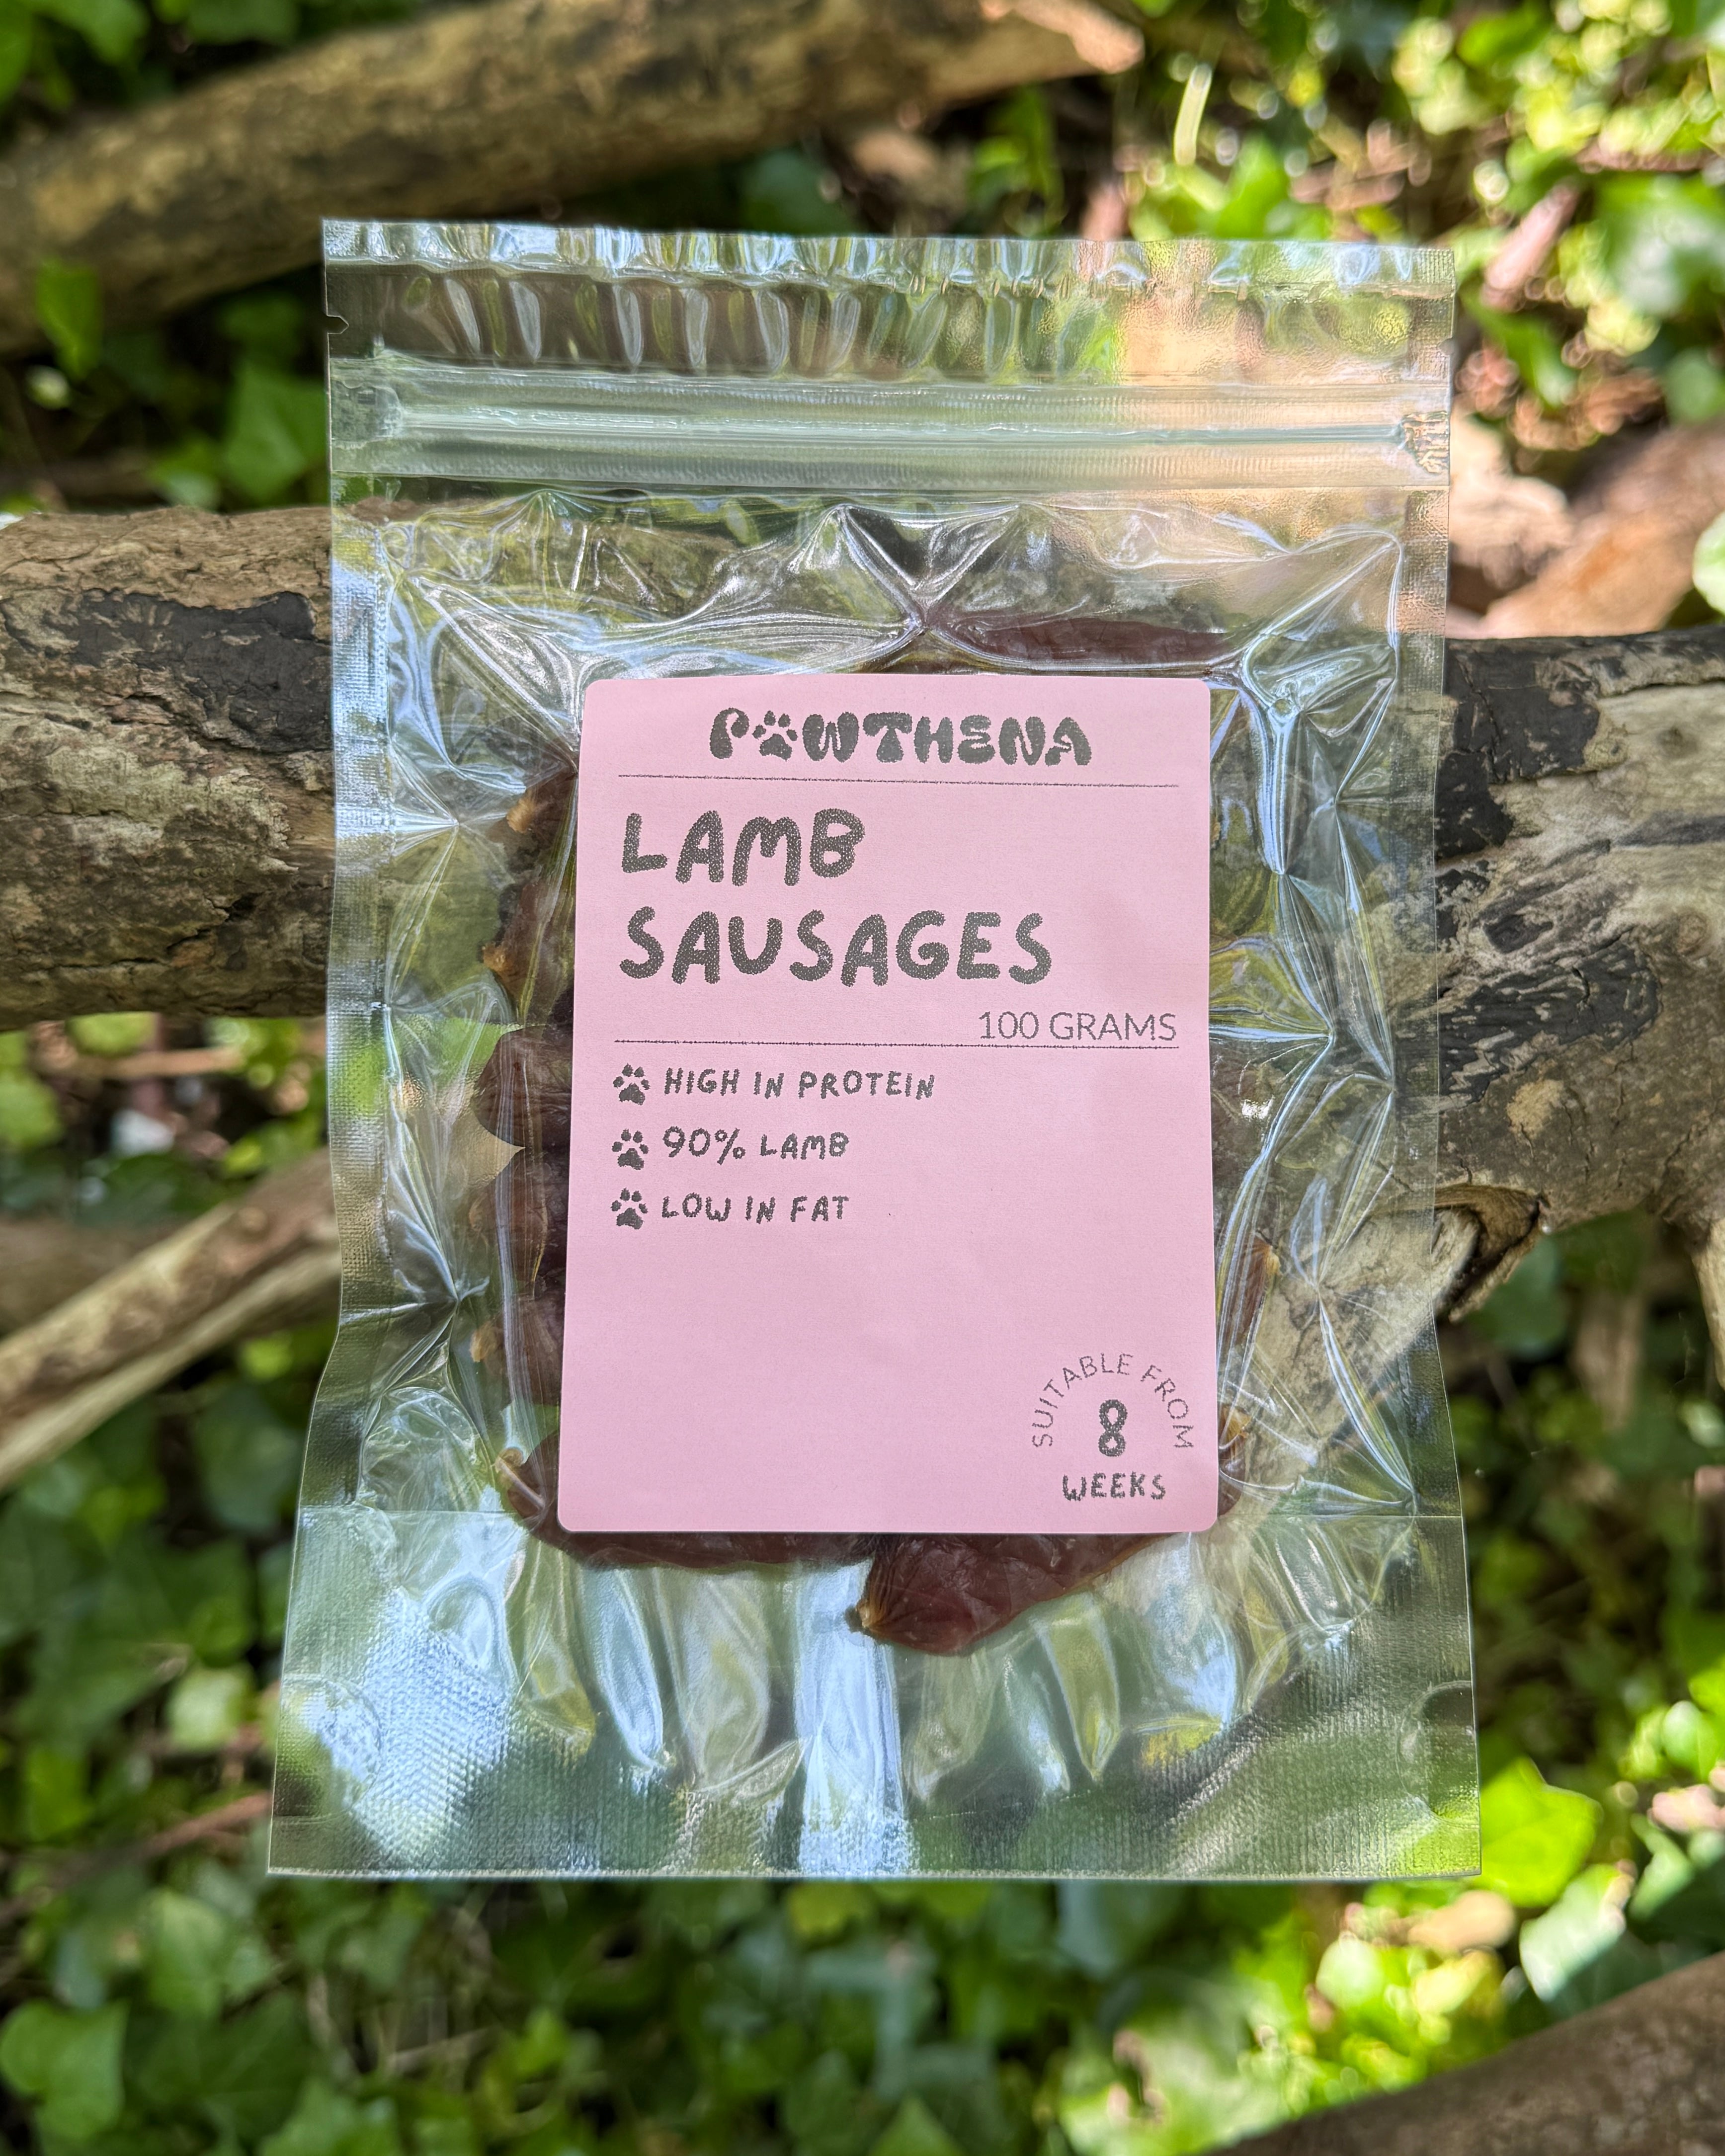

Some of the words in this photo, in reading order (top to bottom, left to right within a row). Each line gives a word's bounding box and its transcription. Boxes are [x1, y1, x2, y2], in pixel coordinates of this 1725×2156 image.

[621, 808, 865, 887] LAMB
[619, 906, 1052, 987] SAUSAGES
[979, 1011, 1039, 1040] 100
[1049, 1012, 1176, 1041] GRAMS
[664, 1067, 740, 1096] HIGH
[753, 1071, 784, 1099] IN
[798, 1070, 935, 1100] PROTEIN
[662, 1126, 746, 1165] 90%
[760, 1132, 849, 1160] LAMB
[661, 1192, 732, 1222] LOW
[745, 1196, 776, 1224] IN
[790, 1196, 849, 1222] FAT
[1032, 1353, 1133, 1447] SUITABLE
[1140, 1364, 1194, 1448] FROM
[1098, 1399, 1128, 1457] 8
[1063, 1471, 1166, 1502] WEEKS
